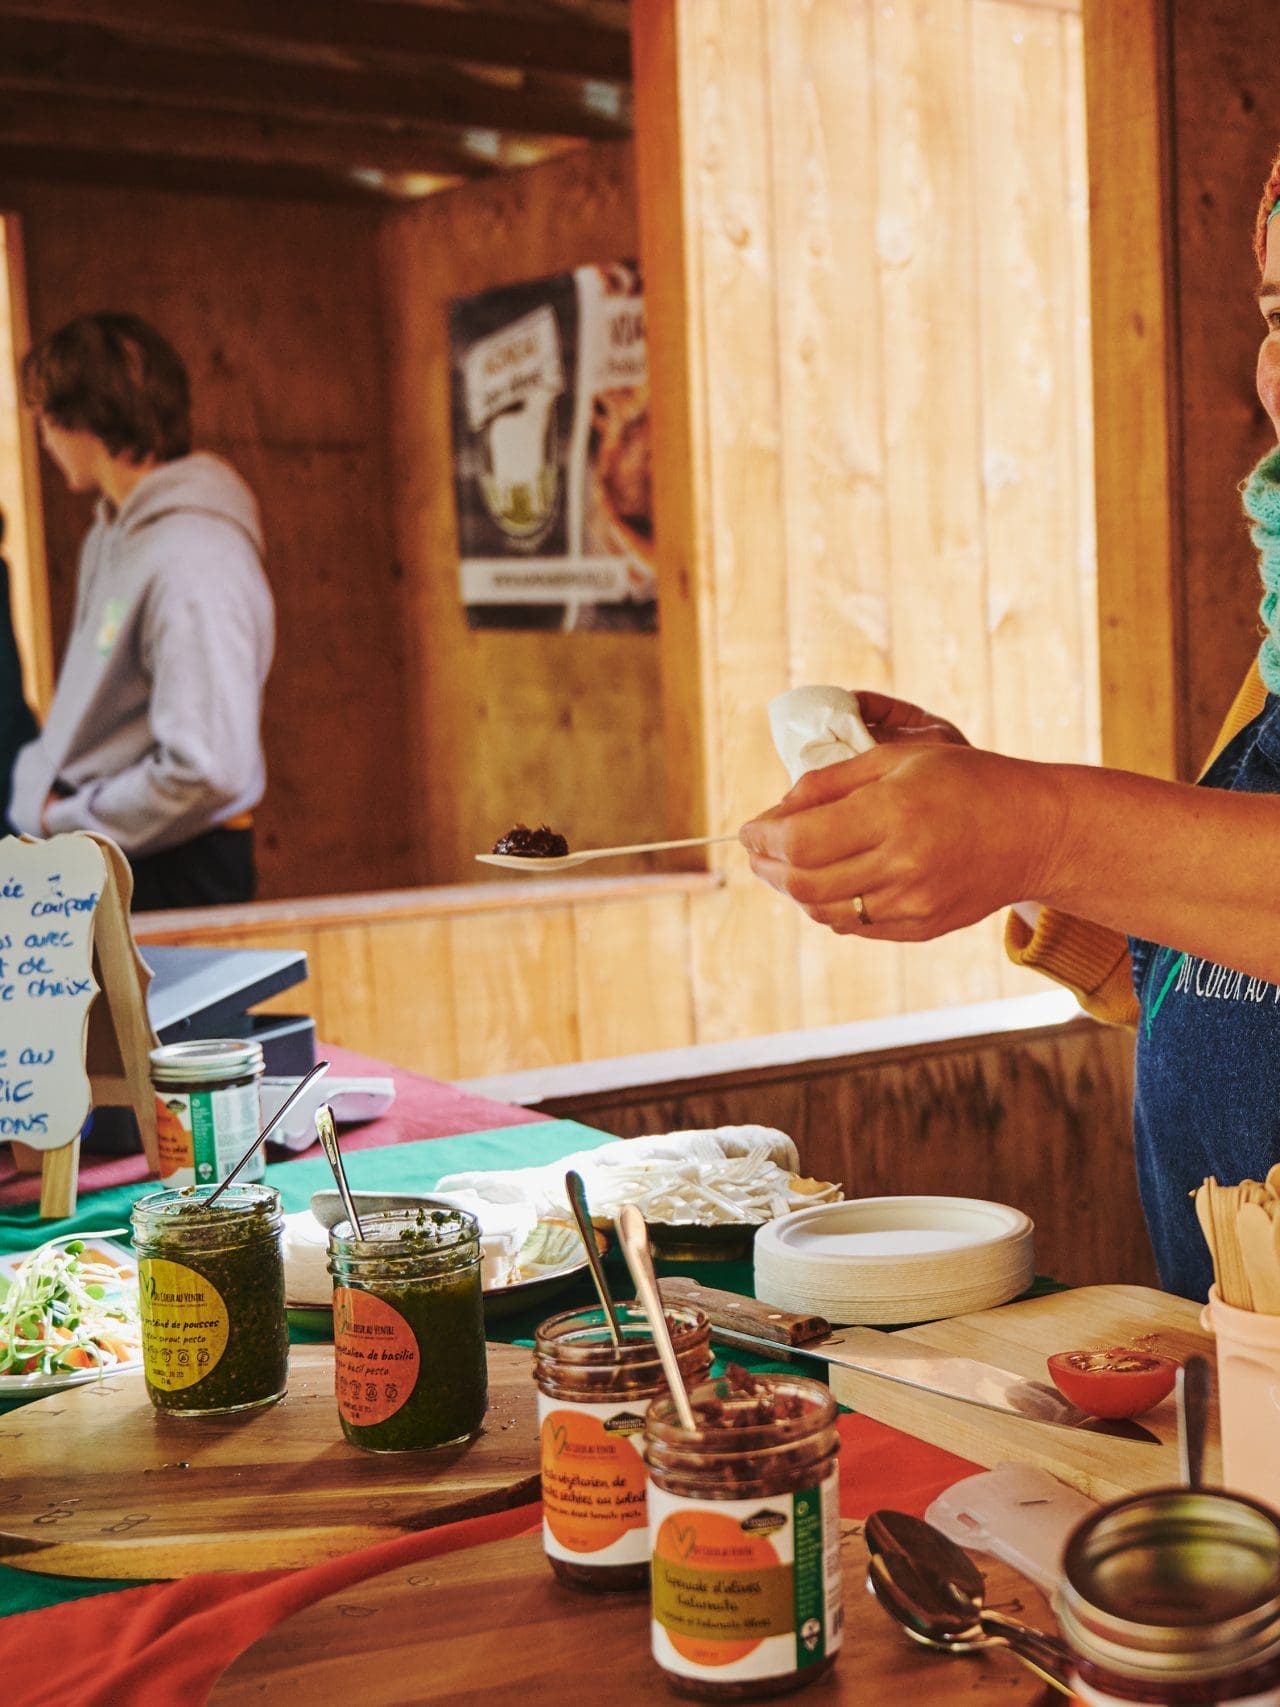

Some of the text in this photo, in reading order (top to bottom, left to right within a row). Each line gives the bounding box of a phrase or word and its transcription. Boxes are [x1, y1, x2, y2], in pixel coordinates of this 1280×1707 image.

[24, 931, 74, 948] avec
[18, 956, 54, 975] de
[28, 977, 92, 997] choix
[19, 1046, 55, 1065] au
[171, 1320, 181, 1329] de
[182, 1319, 220, 1332] pousses
[182, 1335, 207, 1346] pesto
[367, 1349, 379, 1361] de
[381, 1348, 415, 1361] basilic
[365, 1366, 390, 1377] pesto
[612, 1475, 626, 1487] de
